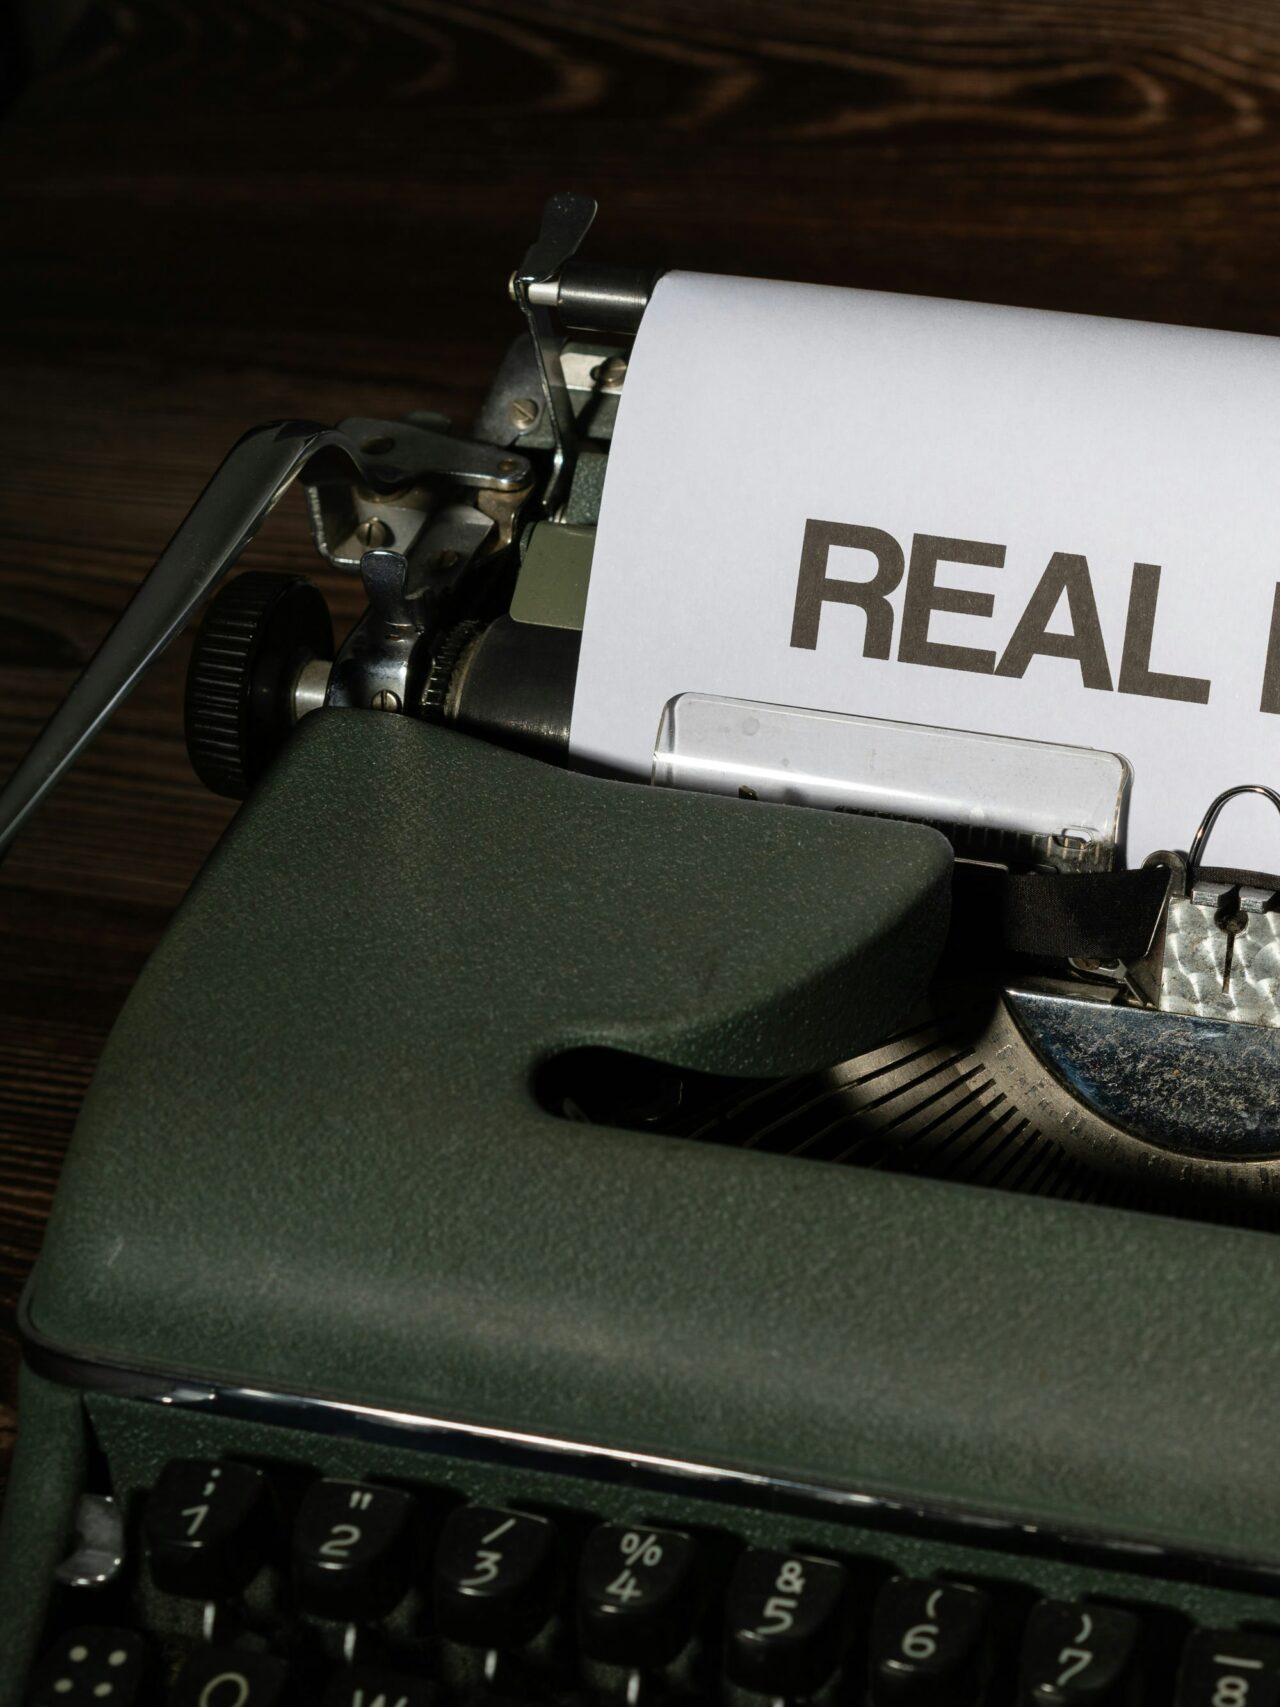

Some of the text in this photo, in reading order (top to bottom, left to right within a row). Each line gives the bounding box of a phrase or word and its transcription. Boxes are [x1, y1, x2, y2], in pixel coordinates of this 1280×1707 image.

[790, 519, 1210, 703] REAL
[180, 1504, 209, 1536] 1
[319, 1524, 361, 1557] 2
[620, 1532, 663, 1567] %
[460, 1550, 502, 1587] 3
[605, 1569, 642, 1602] 4
[775, 1560, 805, 1595] &
[756, 1596, 799, 1635] 5
[901, 1624, 940, 1659] 6
[1057, 1648, 1093, 1687] 7
[1211, 1675, 1250, 1707] 8
